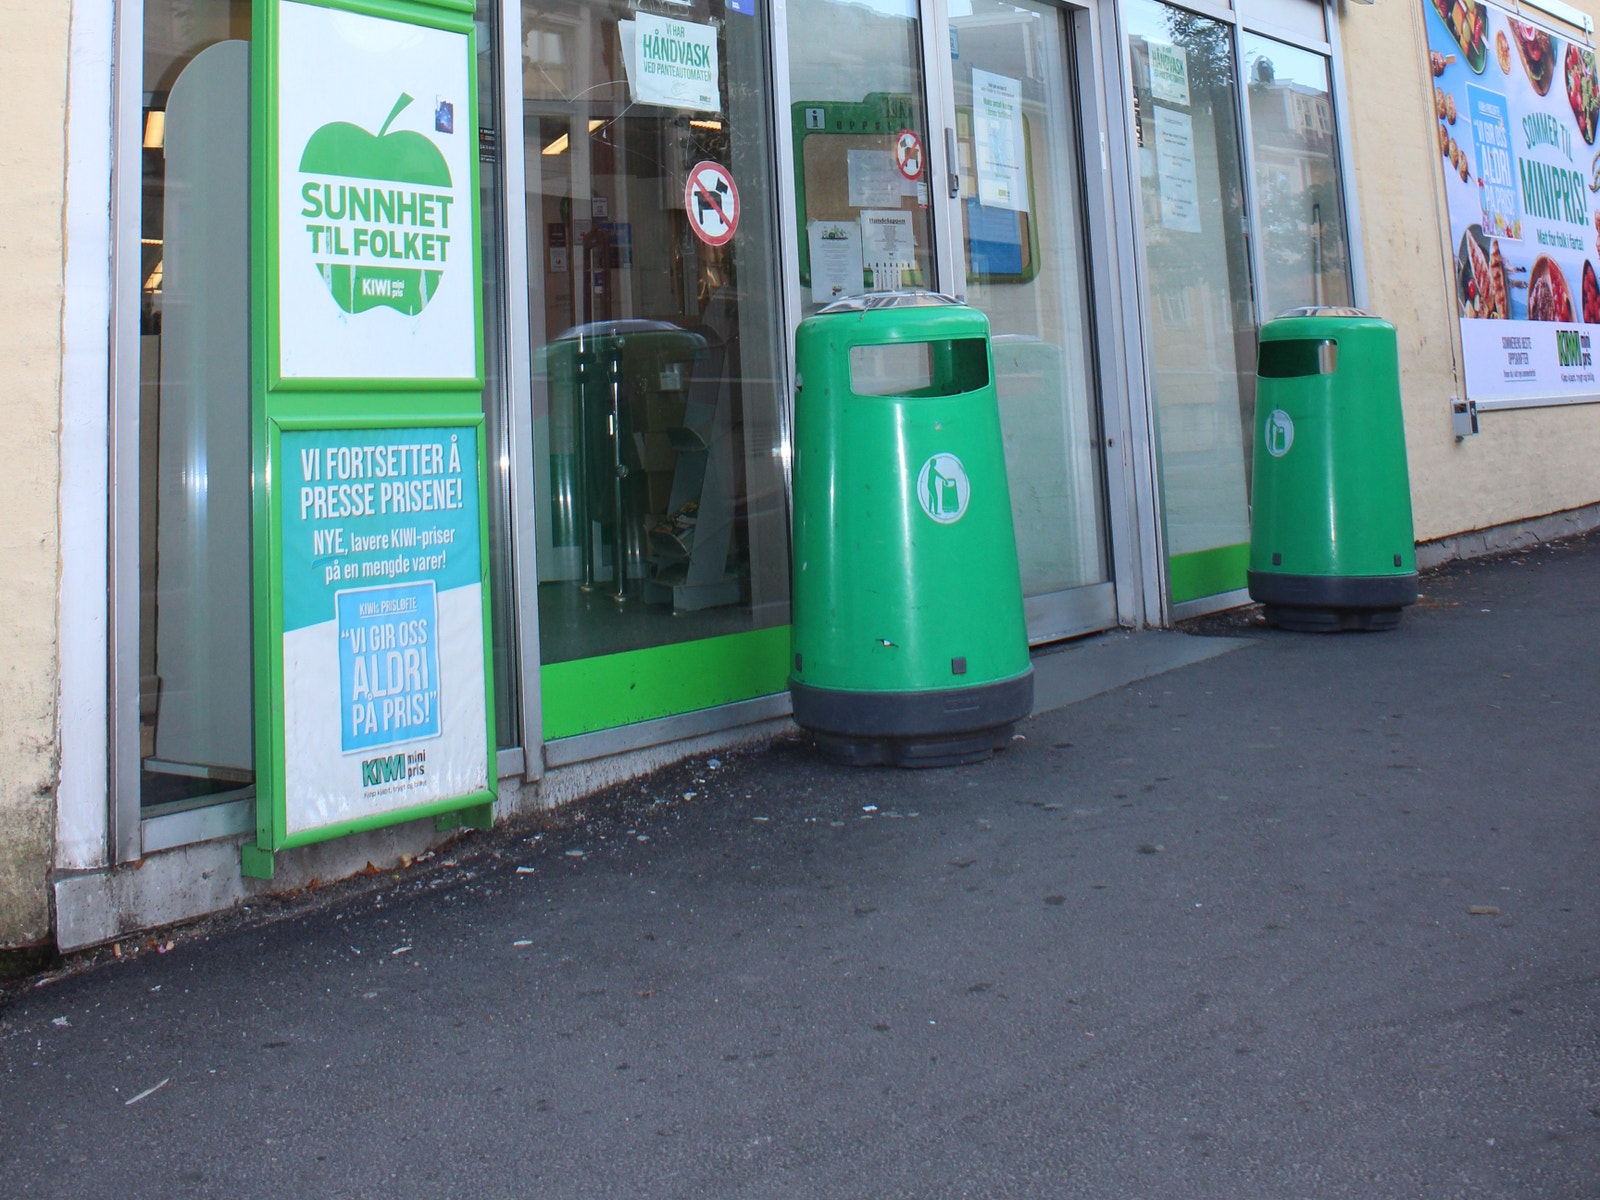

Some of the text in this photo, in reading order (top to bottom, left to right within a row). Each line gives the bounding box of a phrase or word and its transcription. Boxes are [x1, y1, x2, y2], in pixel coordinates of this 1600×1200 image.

[643, 28, 711, 70] HÅNDVASK
[673, 25, 685, 38] HAR
[643, 60, 712, 83] VED PANTEAUTOMATEN
[1522, 112, 1574, 164] SOMMER TIL
[1481, 144, 1513, 188] ALDRI
[301, 182, 454, 229] SUNNHET
[1518, 156, 1590, 227] MINIPRIS!
[306, 224, 450, 262] TIL FOLKET
[362, 277, 391, 297] KIWI
[1555, 329, 1583, 368] KIWI
[301, 433, 461, 482] VI FORTSETTER Å
[301, 478, 463, 520] PRESSE PRISENE!
[313, 525, 456, 557] NYE, lavere KIWI-priser
[325, 549, 446, 585] på en mengde varer!
[380, 596, 417, 614] PRISLØFTE
[369, 623, 396, 651] GIR
[398, 619, 428, 649] OSS
[353, 647, 429, 703] ALDRI
[352, 693, 378, 738] PÅ
[362, 753, 406, 788] KIWI
[407, 749, 426, 765] mini
[407, 763, 425, 781] pris
